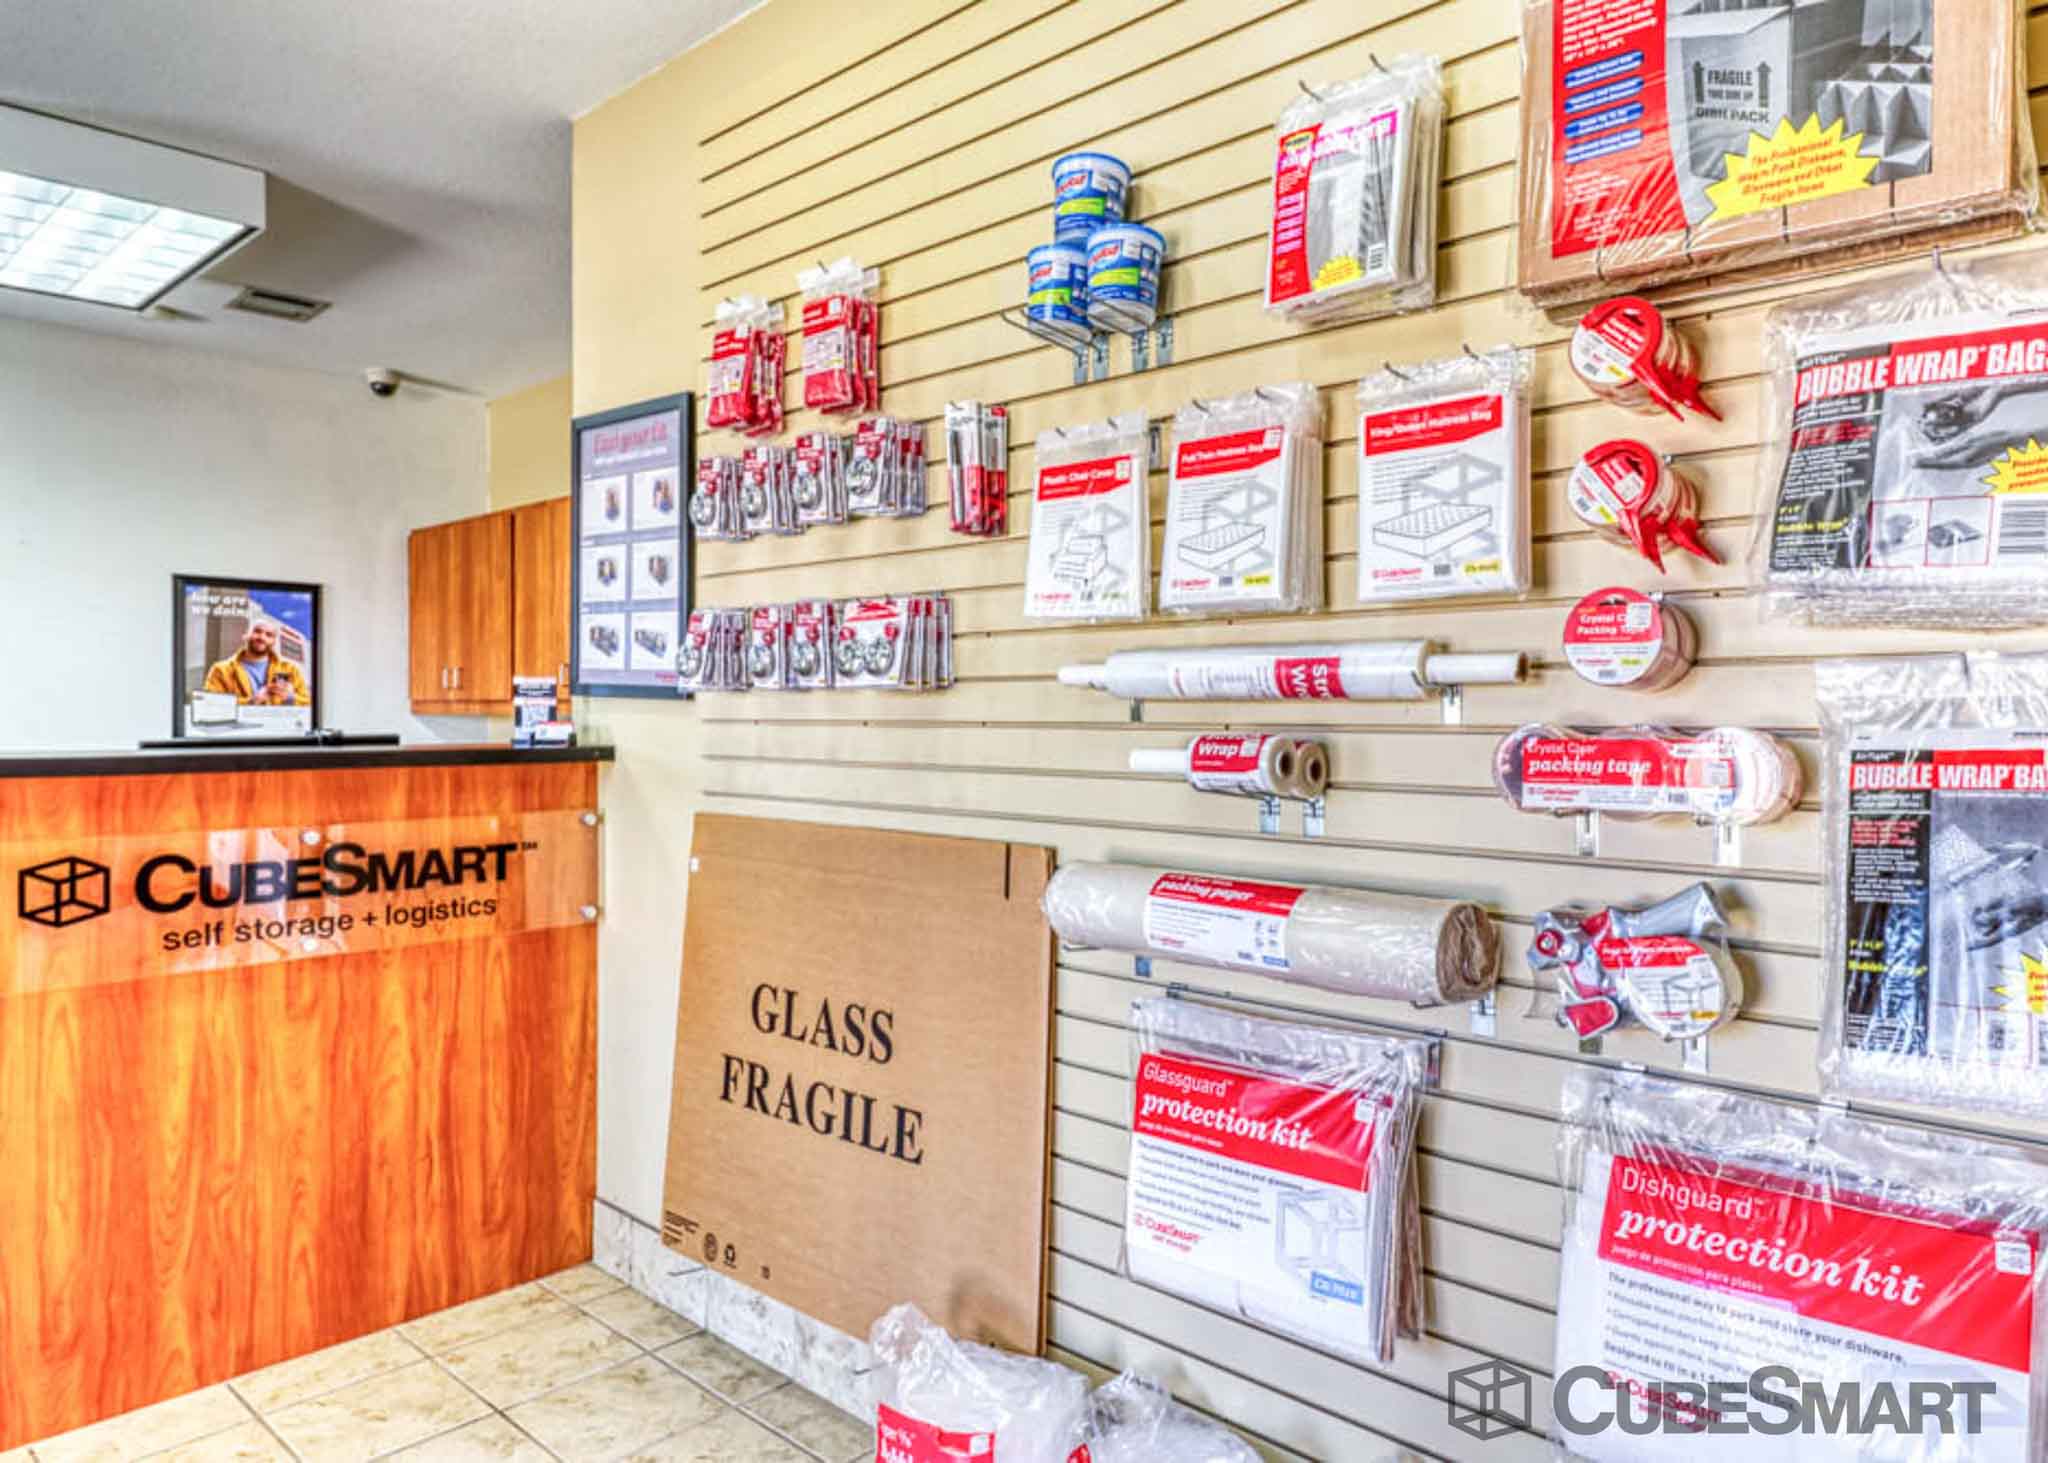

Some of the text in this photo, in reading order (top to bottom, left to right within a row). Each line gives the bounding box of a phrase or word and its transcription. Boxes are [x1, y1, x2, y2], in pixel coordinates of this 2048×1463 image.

[1707, 69, 1753, 86] FRAGILE
[1729, 110, 1770, 123] PACK
[1797, 356, 1891, 404] BUBBLE
[1985, 338, 2048, 376] BAG
[1471, 410, 1492, 422] Bag
[1199, 742, 1239, 758] Wrap
[1528, 755, 1652, 778] packing tape
[1853, 764, 1932, 789] BUBBLE
[1937, 764, 2008, 789] WRAP
[162, 897, 498, 952] self storage + logistics
[751, 983, 895, 1065] GLASS
[1142, 1062, 1228, 1098] Glassguard
[719, 1052, 925, 1165] FRAGILE
[1140, 1092, 1267, 1142] protection
[1271, 1116, 1315, 1150] kit
[1620, 1166, 1753, 1221] Dishguard
[1613, 1205, 1926, 1306] protection kit
[1814, 1331, 1842, 1347] your
